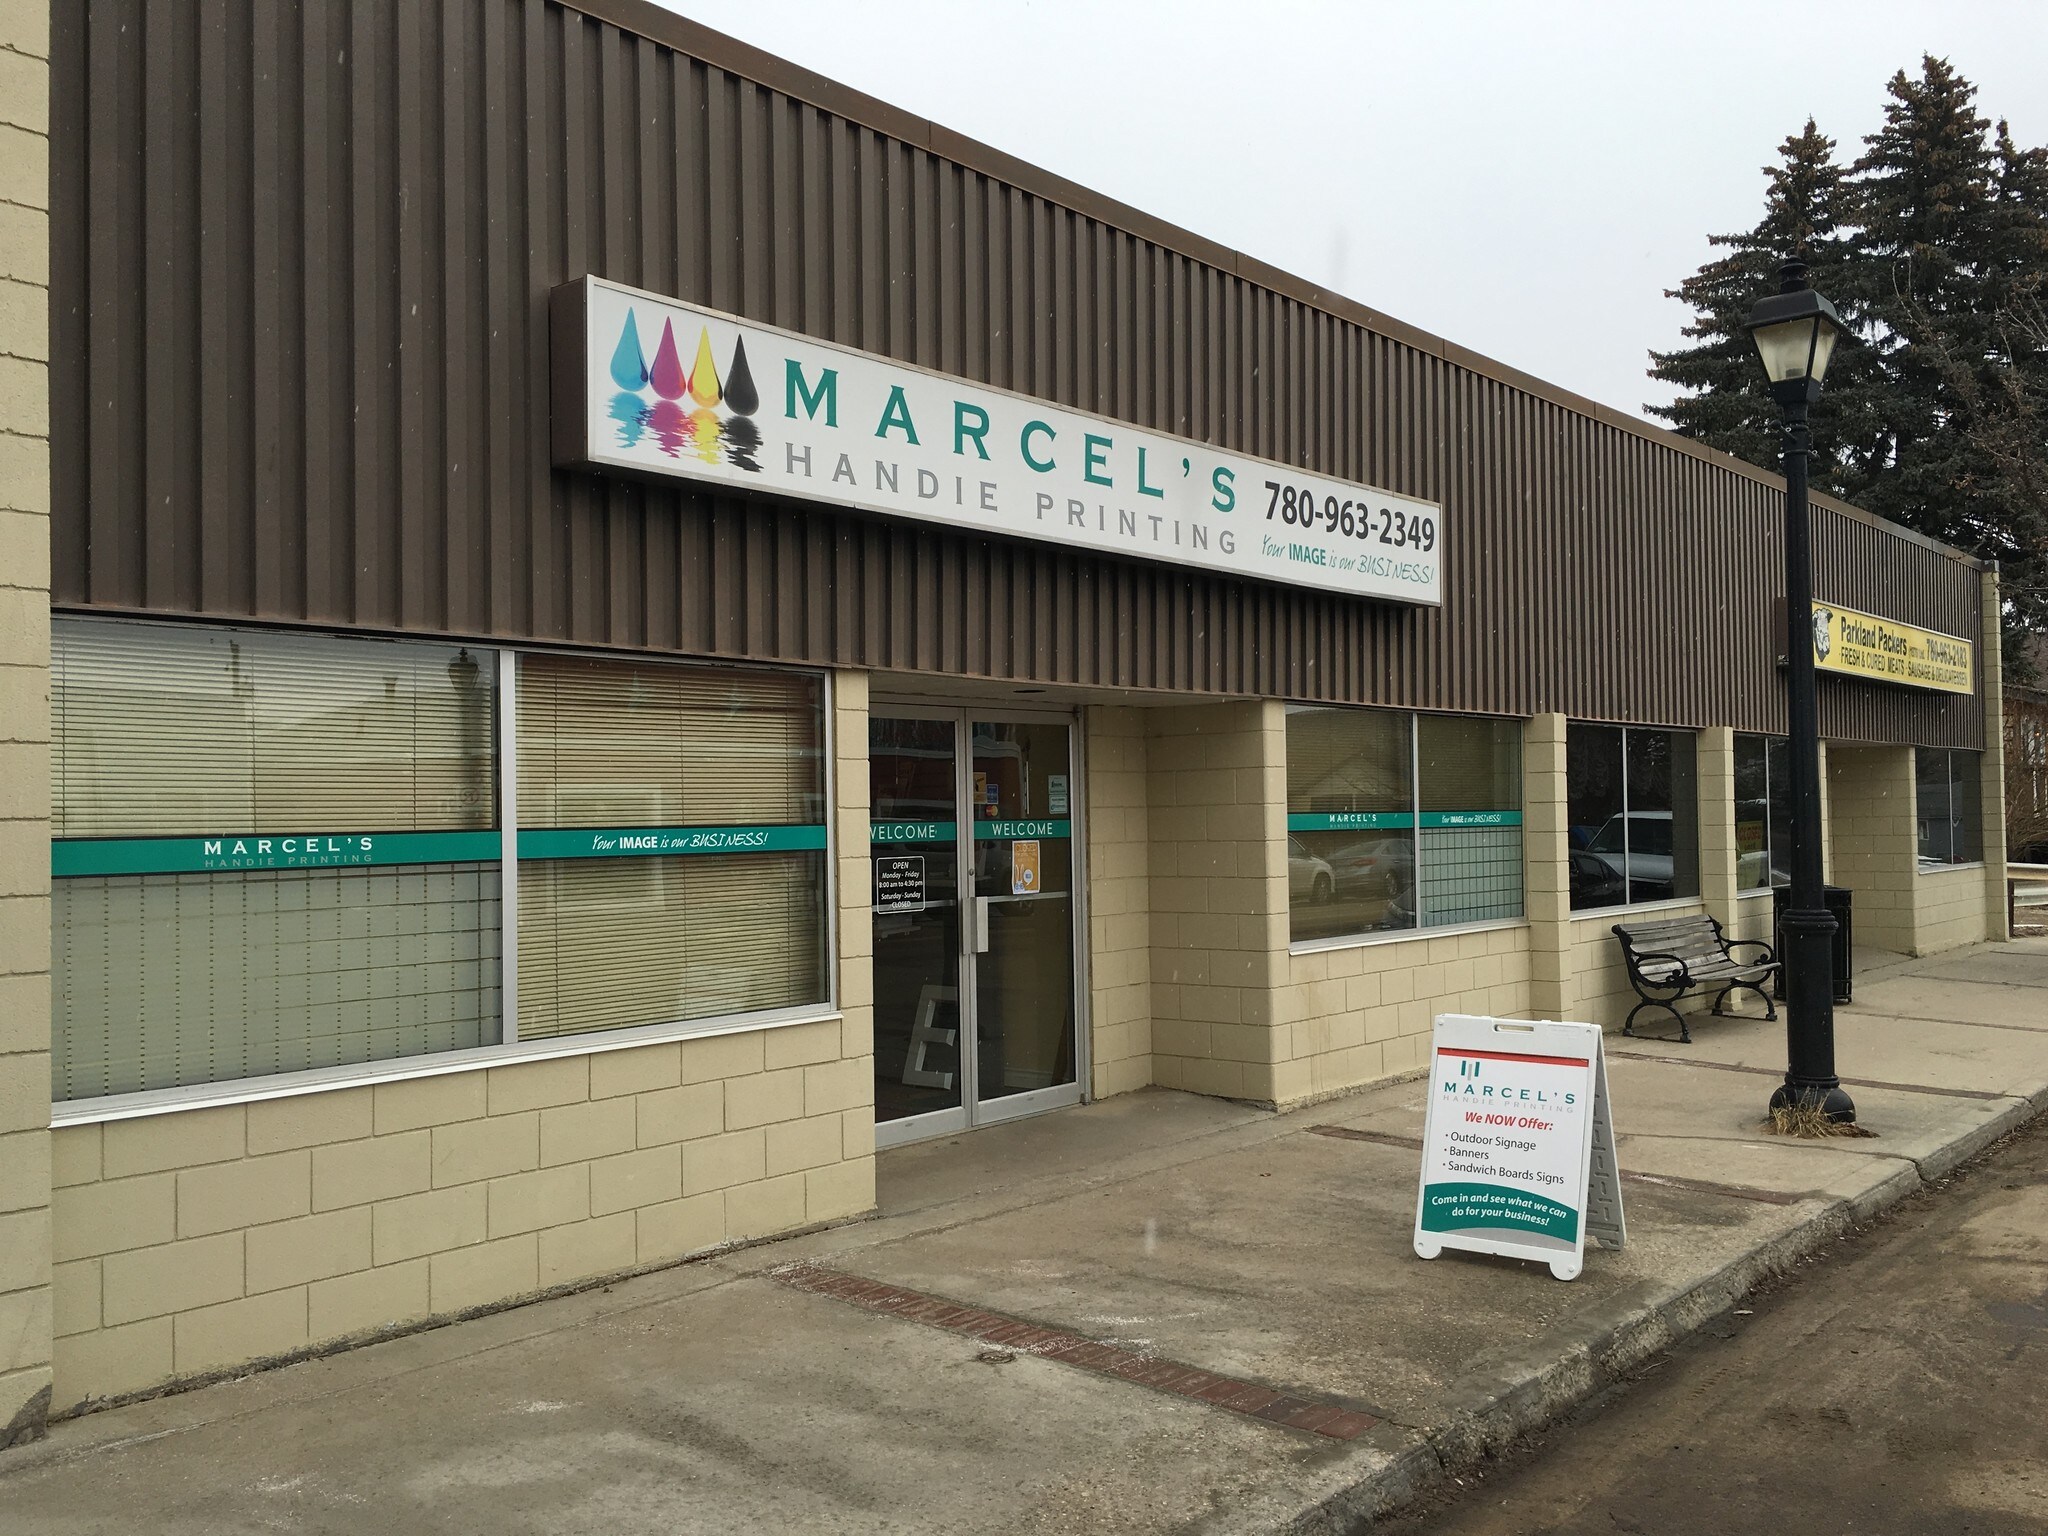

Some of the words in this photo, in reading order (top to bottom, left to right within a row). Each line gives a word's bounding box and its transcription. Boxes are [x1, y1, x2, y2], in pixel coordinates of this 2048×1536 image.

[784, 358, 1236, 513] MARCEL'S
[785, 442, 998, 512] HANDIE
[1036, 492, 1236, 555] PRINTING
[1264, 480, 1435, 553] 780-963-2349
[1262, 534, 1285, 557] Your
[1288, 543, 1327, 566] IMAGE
[1329, 550, 1336, 567] is
[1339, 557, 1356, 571] our
[1357, 554, 1435, 585] BUSINESS!
[1840, 616, 1876, 648] Parkland
[1878, 625, 1907, 655] Packers
[1841, 646, 1860, 666] FRESH
[1861, 651, 1866, 668] &
[1866, 652, 1885, 671] CURED
[1887, 656, 1905, 675] MEATS
[1908, 661, 1931, 680] SAUSAGE
[1329, 813, 1377, 823] MARCEL'S
[991, 822, 1053, 836] WELCOME
[203, 836, 373, 856] MARCEL'S
[592, 834, 617, 850] Your
[619, 836, 658, 849] IMAGE
[660, 835, 669, 848] is
[671, 838, 689, 848] our
[689, 832, 769, 848] BUSINESS!
[204, 857, 275, 867] HANDIE
[288, 854, 373, 865] PRINTING
[892, 861, 909, 870] OPEN
[905, 871, 920, 879] Friday
[891, 901, 912, 909] CLOSED
[904, 891, 921, 899] Sunday
[1444, 1081, 1576, 1105] MARCEL'S
[1443, 1094, 1495, 1105] HANDIE
[1504, 1101, 1574, 1114] PRINTING
[1465, 1111, 1483, 1123] We
[1485, 1113, 1517, 1127] NOW
[1518, 1117, 1554, 1131] Offer:
[1450, 1131, 1493, 1146] Outdoor
[1495, 1136, 1537, 1152] Signage
[1449, 1146, 1489, 1160] Banners
[1448, 1160, 1496, 1176] Sandwich
[1499, 1167, 1534, 1181] Boards
[1536, 1171, 1565, 1185] Signs
[1431, 1194, 1458, 1206] Come
[1459, 1193, 1469, 1203] in
[1470, 1193, 1489, 1203] and
[1490, 1195, 1506, 1204] see
[1507, 1196, 1533, 1209] what
[1533, 1202, 1548, 1213] we
[1548, 1207, 1567, 1219] can
[1452, 1207, 1464, 1217] do
[1465, 1206, 1480, 1216] for
[1480, 1208, 1503, 1218] your
[1504, 1208, 1550, 1226] business!
